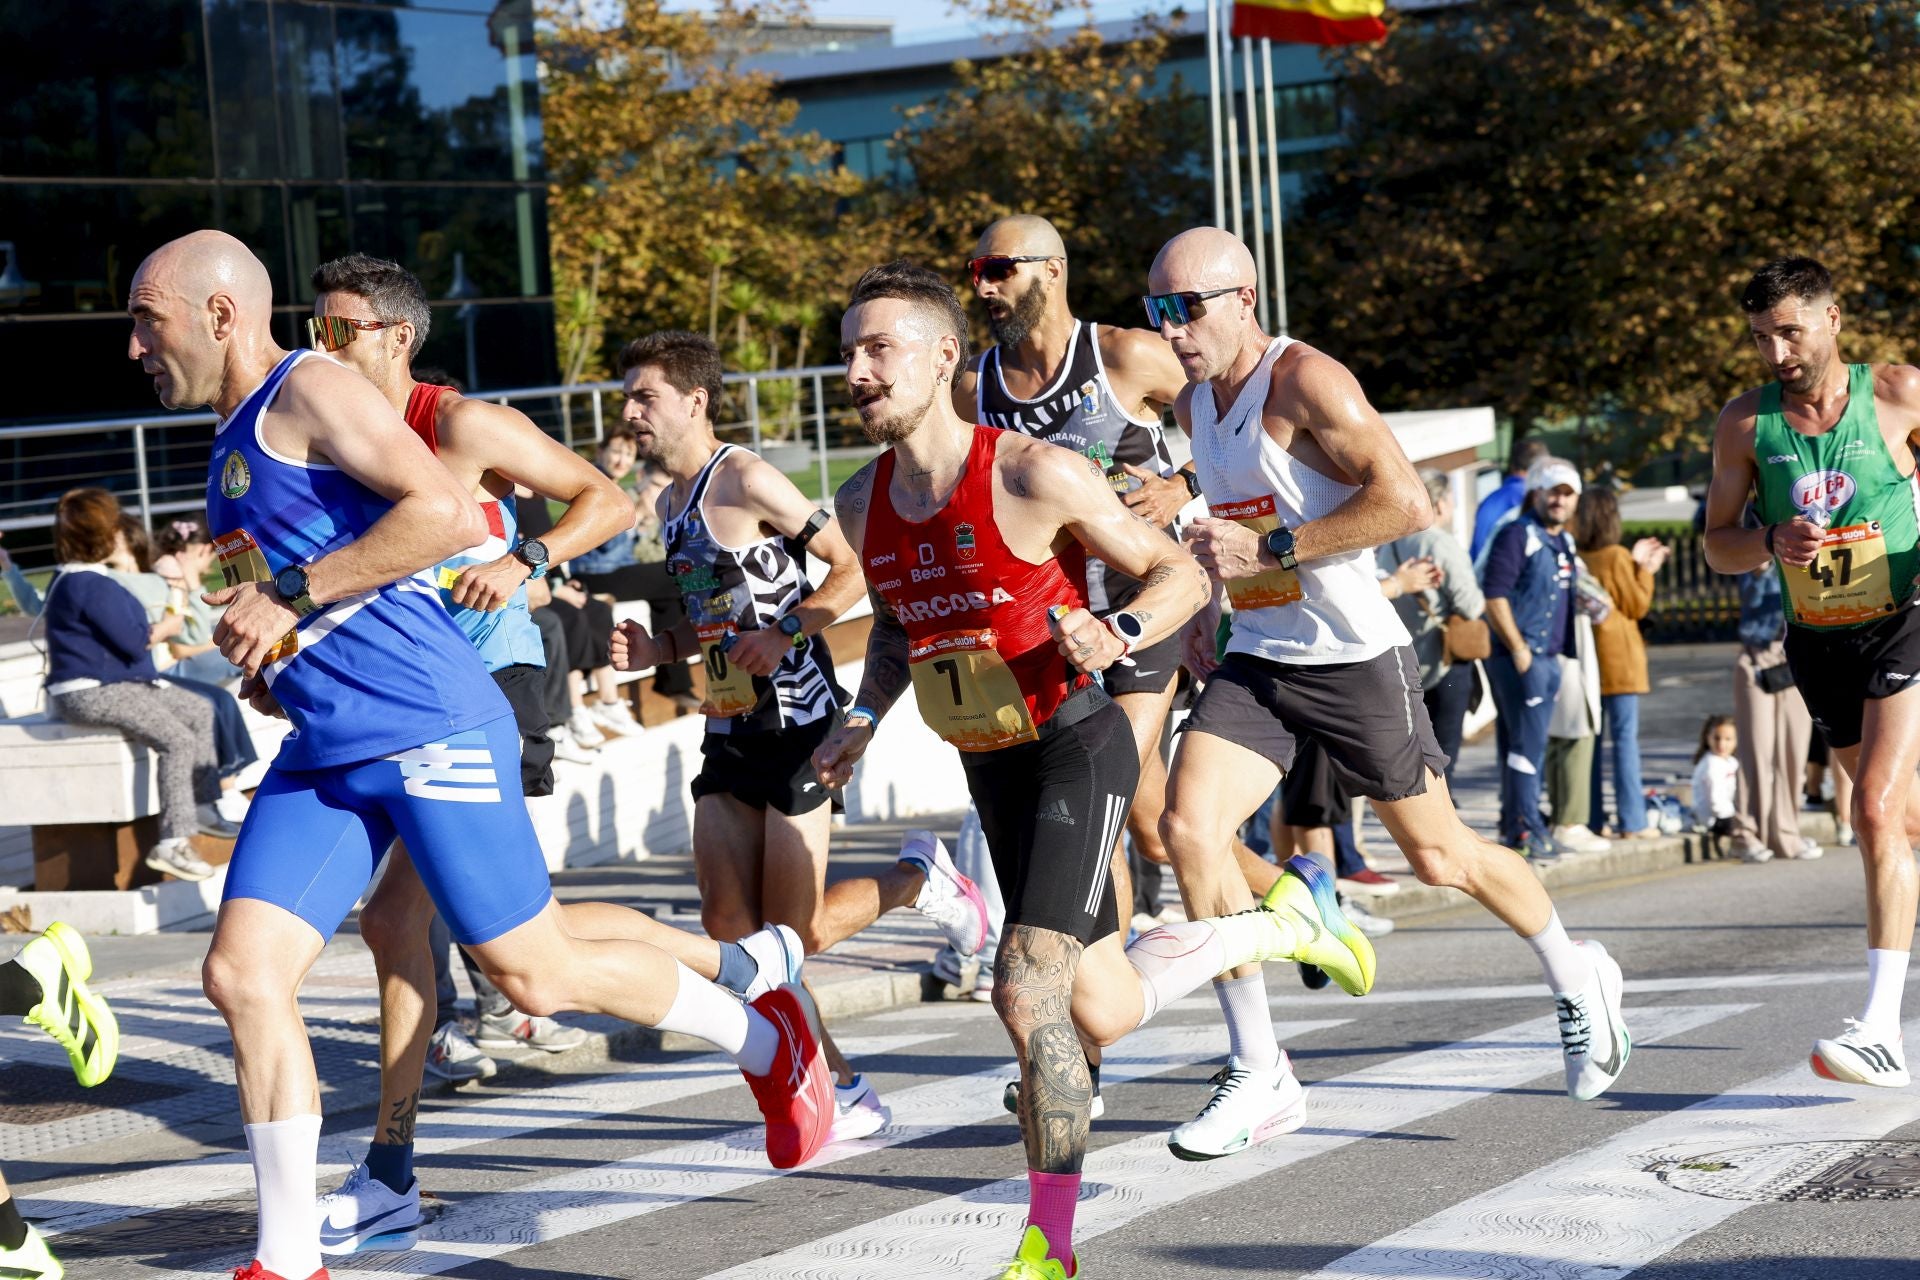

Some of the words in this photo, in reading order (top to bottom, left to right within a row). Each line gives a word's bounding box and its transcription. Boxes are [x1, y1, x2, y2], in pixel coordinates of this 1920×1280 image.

[1042, 432, 1087, 446] AURANTE
[910, 565, 946, 583] Beco
[1810, 548, 1852, 588] 47
[955, 635, 976, 647] GIJÓN
[932, 659, 962, 706] 7
